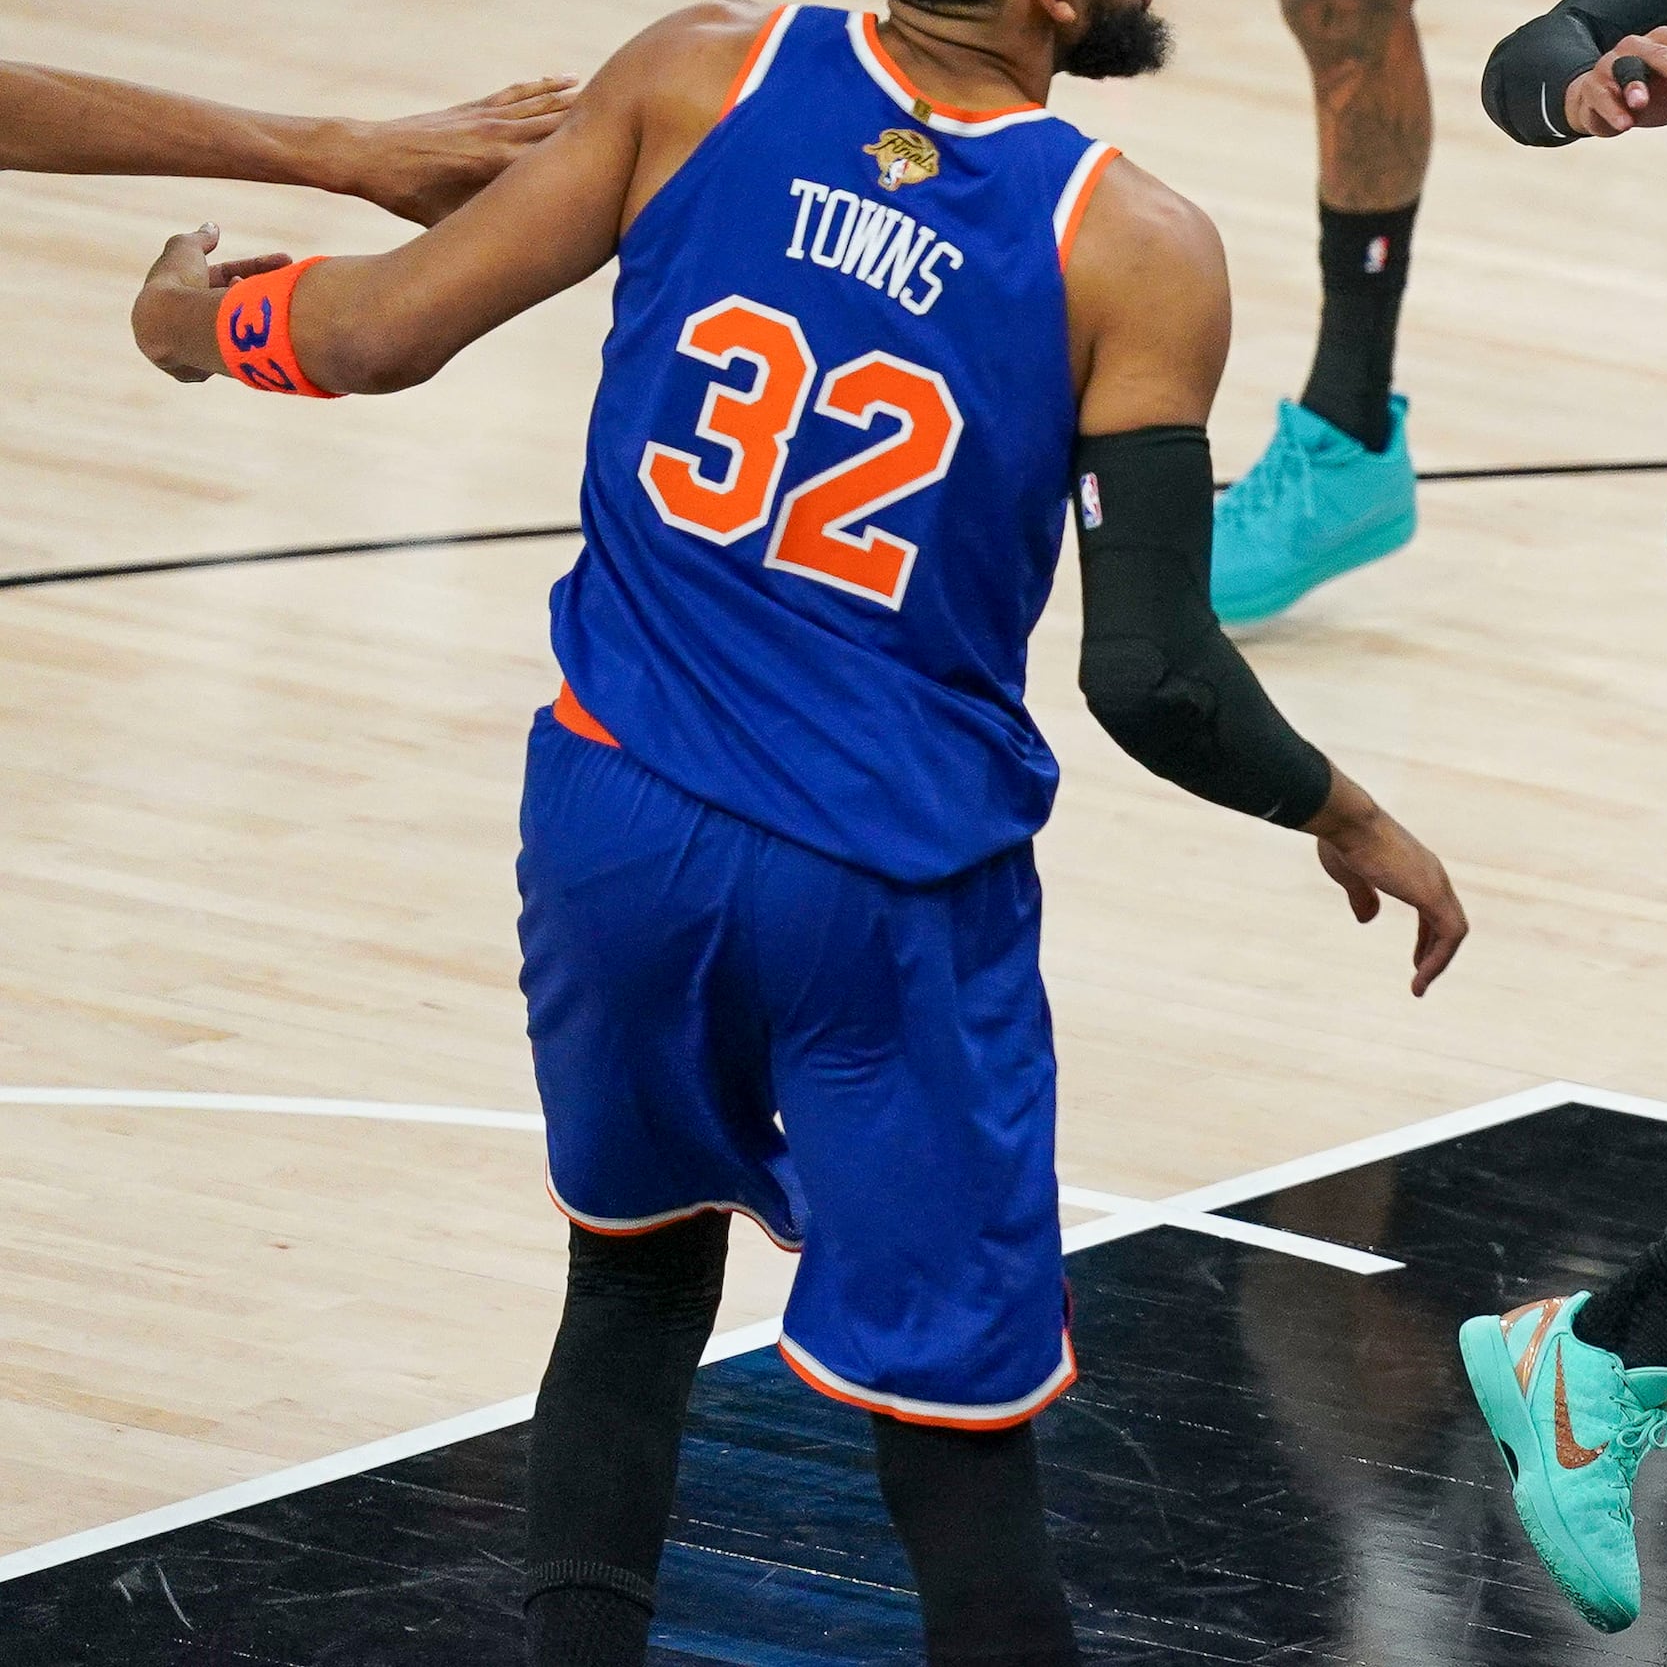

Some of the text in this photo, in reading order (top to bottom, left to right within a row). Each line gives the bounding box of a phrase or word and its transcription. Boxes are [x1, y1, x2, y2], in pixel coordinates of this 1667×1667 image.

[785, 177, 965, 316] TOWNS
[229, 295, 298, 392] 32
[637, 294, 965, 612] 32
